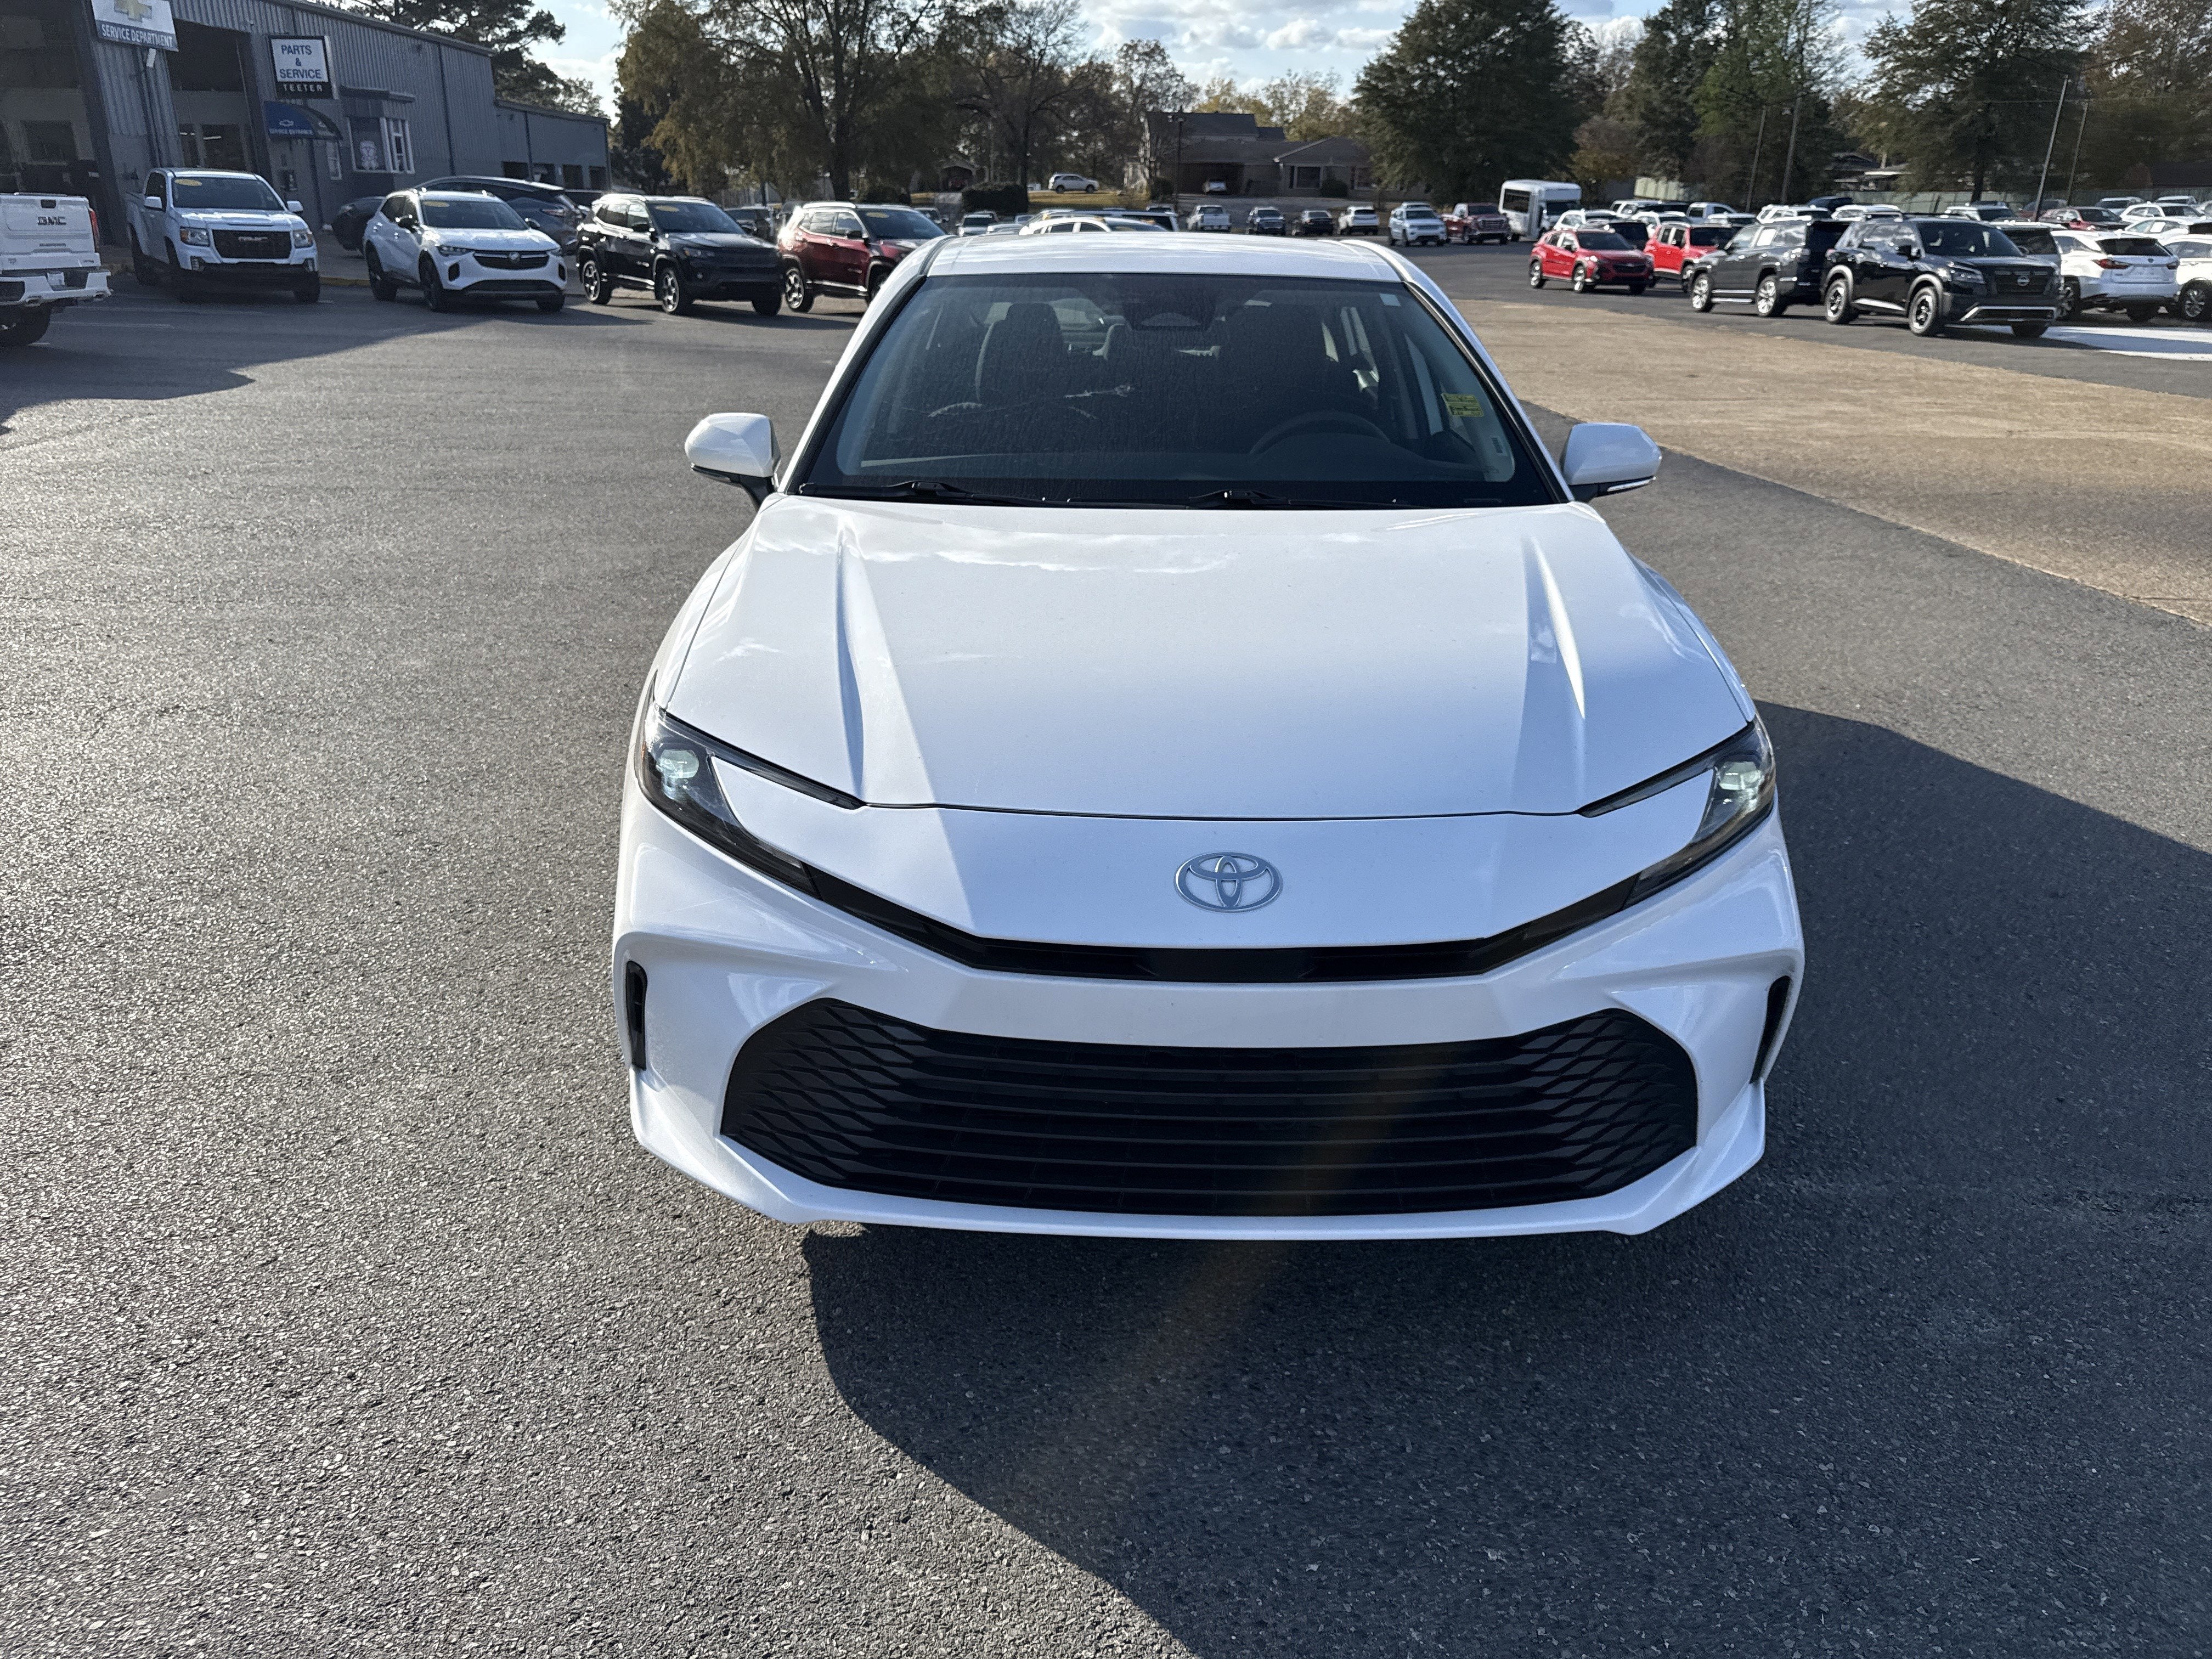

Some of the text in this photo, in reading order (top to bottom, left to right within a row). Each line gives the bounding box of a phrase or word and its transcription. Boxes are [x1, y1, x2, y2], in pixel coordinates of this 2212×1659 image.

[101, 24, 173, 47] SERVICE DEPARTMENT
[281, 44, 312, 55] PARTS
[295, 58, 302, 66] &
[279, 69, 322, 79] SERVICE
[283, 84, 323, 92] TEETER
[37, 216, 67, 225] GMC
